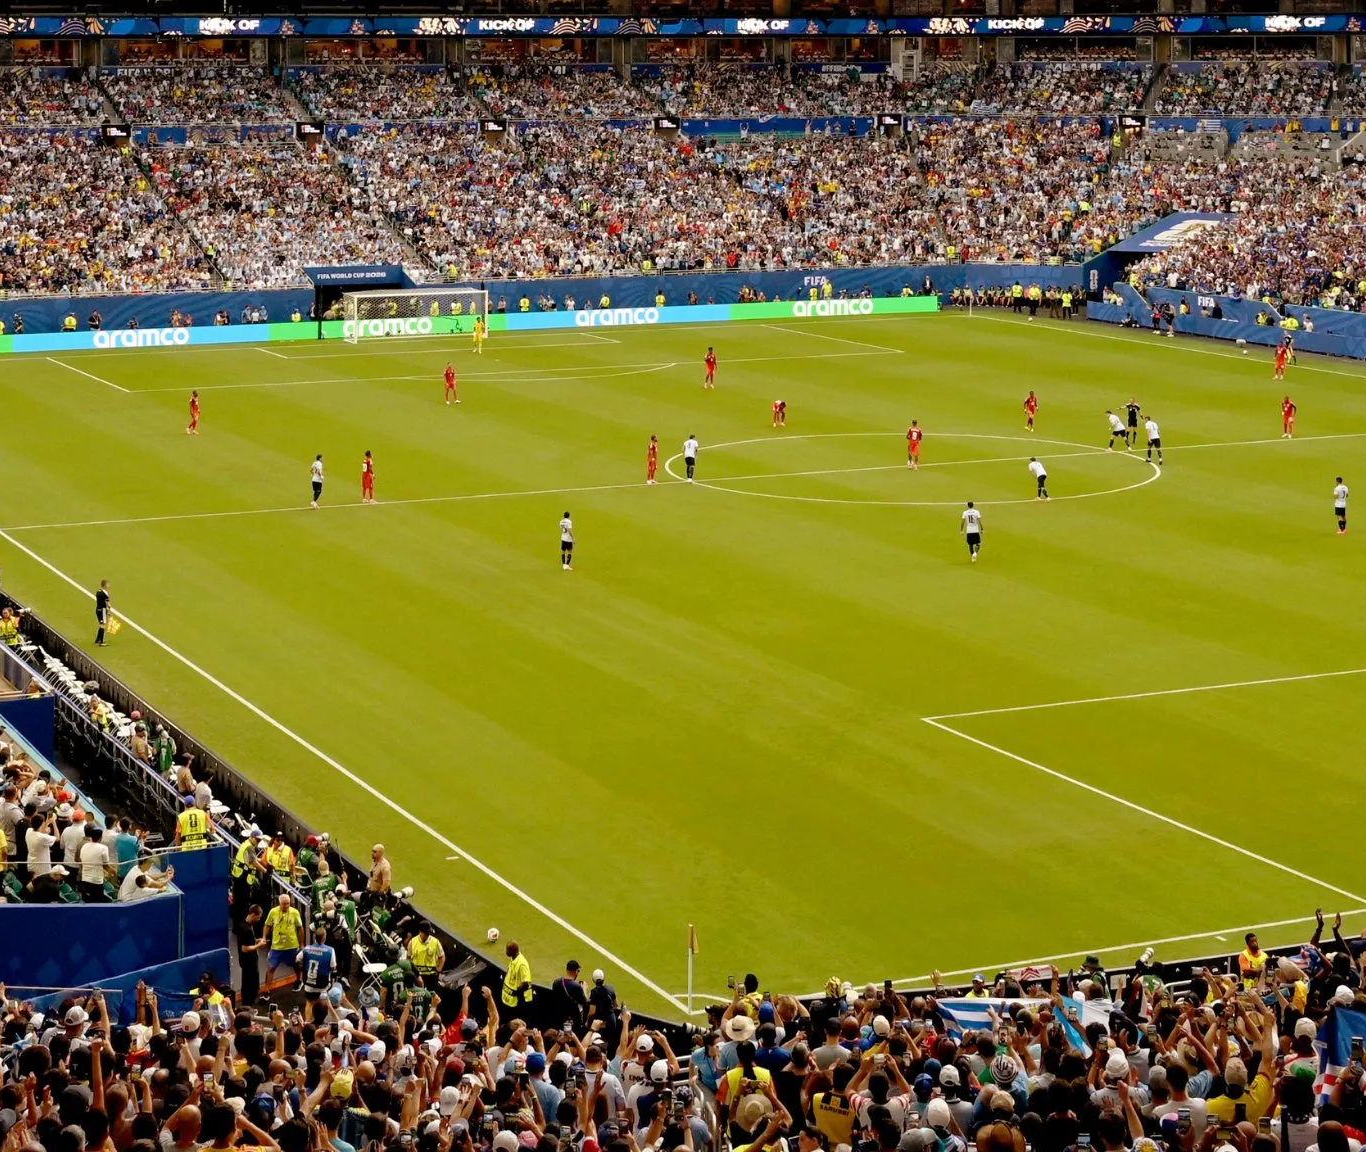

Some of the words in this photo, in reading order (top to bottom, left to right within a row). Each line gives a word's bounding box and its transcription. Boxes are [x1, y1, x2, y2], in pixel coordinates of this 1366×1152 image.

[199, 19, 236, 30] KICK
[238, 19, 260, 30] OF
[479, 20, 514, 30] KICK
[737, 20, 769, 30] KICK
[770, 20, 789, 30] OF
[988, 19, 1023, 30] KICK
[1265, 17, 1303, 28] KICK
[1304, 17, 1326, 27] OF
[804, 276, 826, 286] FIFA
[1197, 295, 1215, 307] FIFA
[793, 298, 874, 317] aramco
[575, 306, 659, 327] aramco
[343, 316, 432, 337] aramco
[93, 327, 190, 348] aramco
